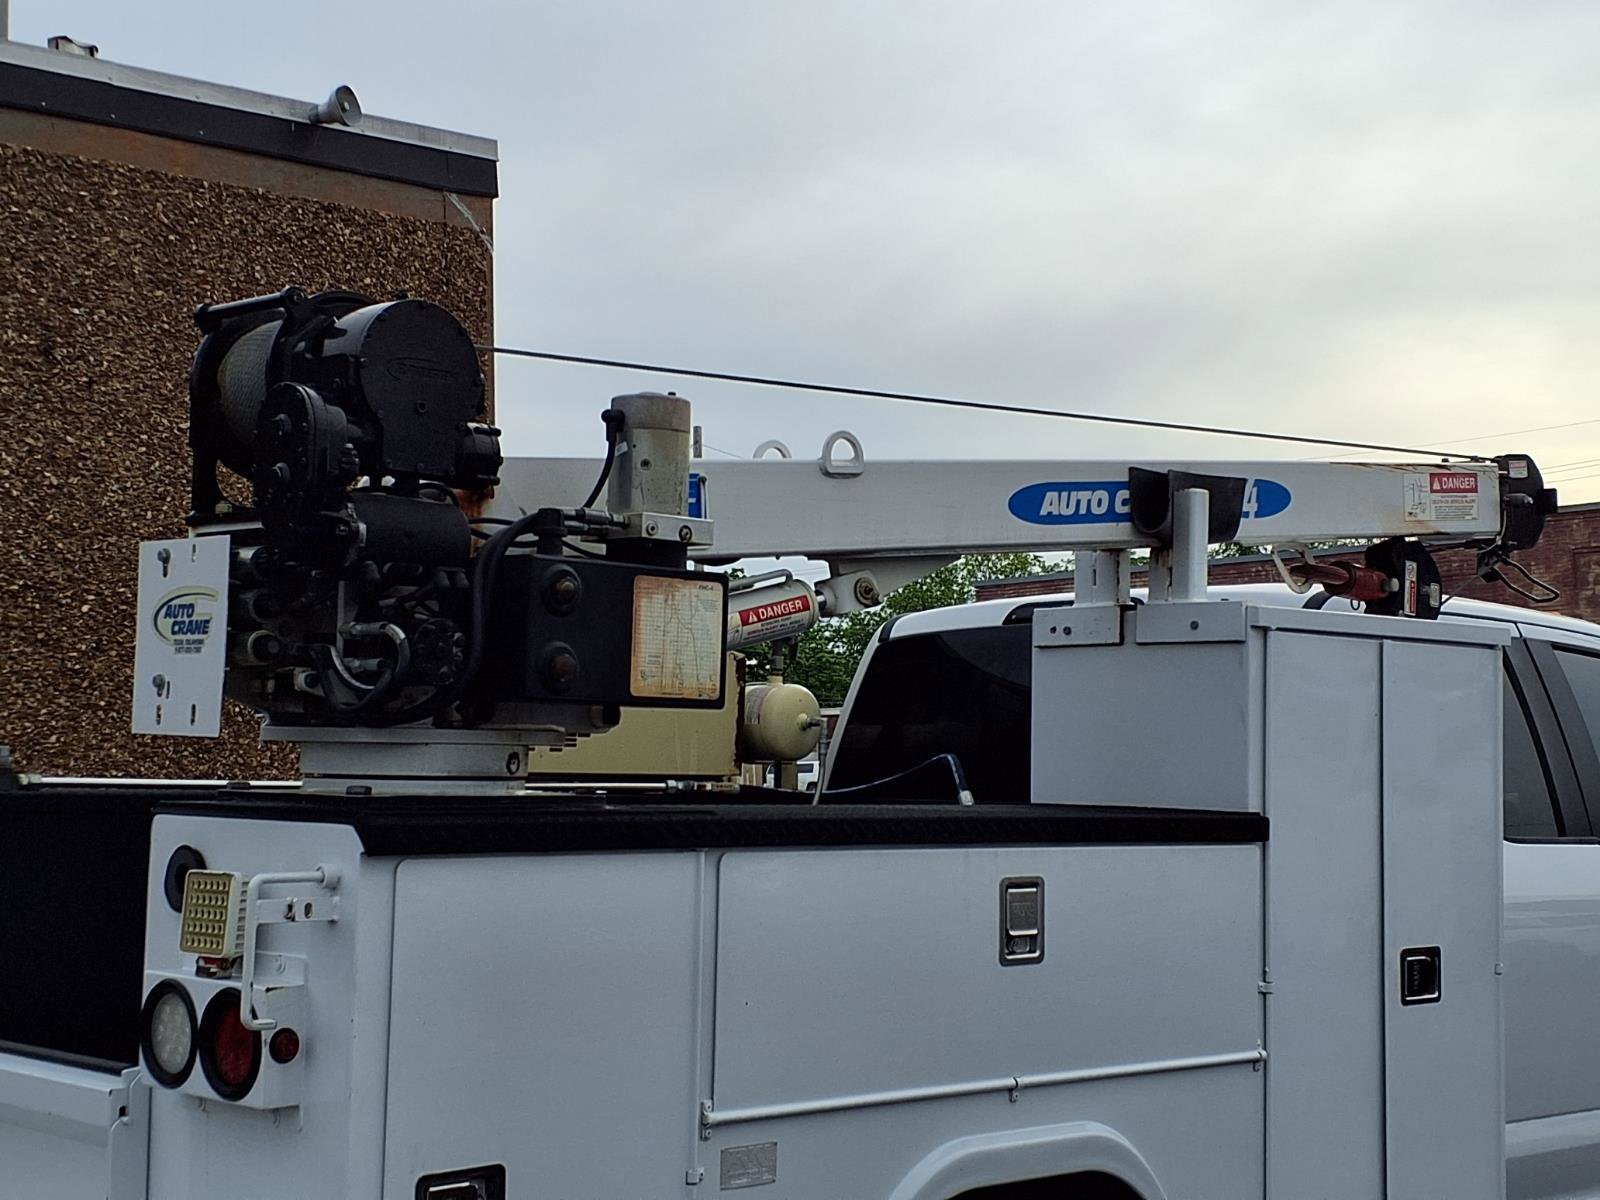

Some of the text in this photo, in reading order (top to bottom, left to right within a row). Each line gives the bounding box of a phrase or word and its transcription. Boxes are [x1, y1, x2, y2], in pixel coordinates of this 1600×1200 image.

[1441, 477, 1476, 490] DANGER
[1039, 490, 1110, 516] AUTO
[163, 602, 195, 619] AUTO
[758, 600, 804, 620] DANGER
[171, 618, 211, 636] CRANE
